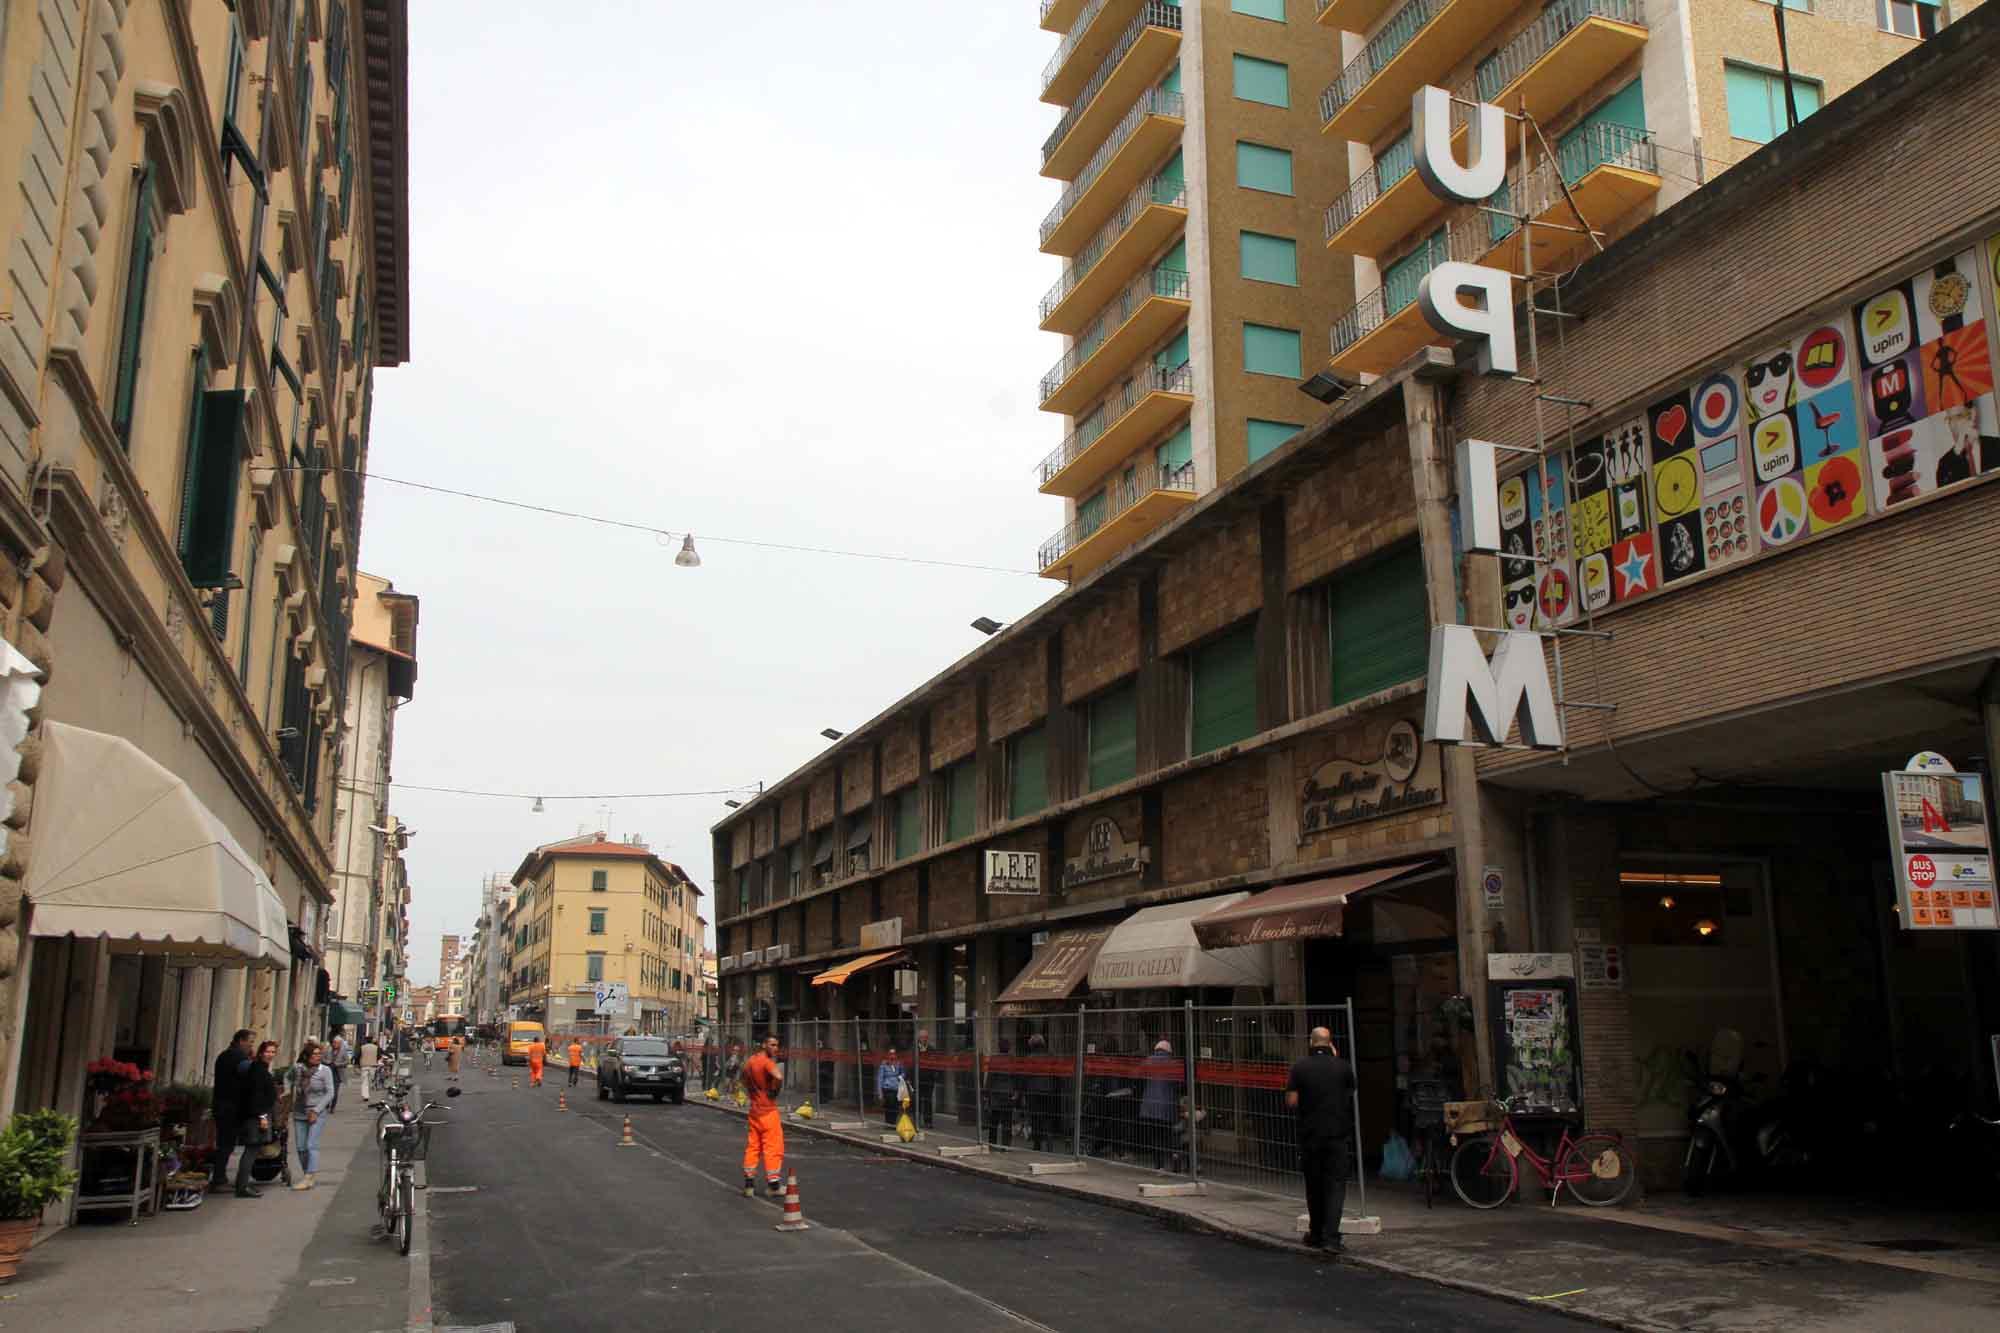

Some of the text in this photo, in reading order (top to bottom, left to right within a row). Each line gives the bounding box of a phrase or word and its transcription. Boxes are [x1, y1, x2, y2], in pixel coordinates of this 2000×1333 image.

[1872, 331, 1905, 355] upim
[1879, 371, 1901, 397] M
[1762, 453, 1790, 474] upim
[1504, 508, 1523, 524] upim
[1912, 860, 1932, 871] BUS
[1911, 871, 1936, 881] STOP
